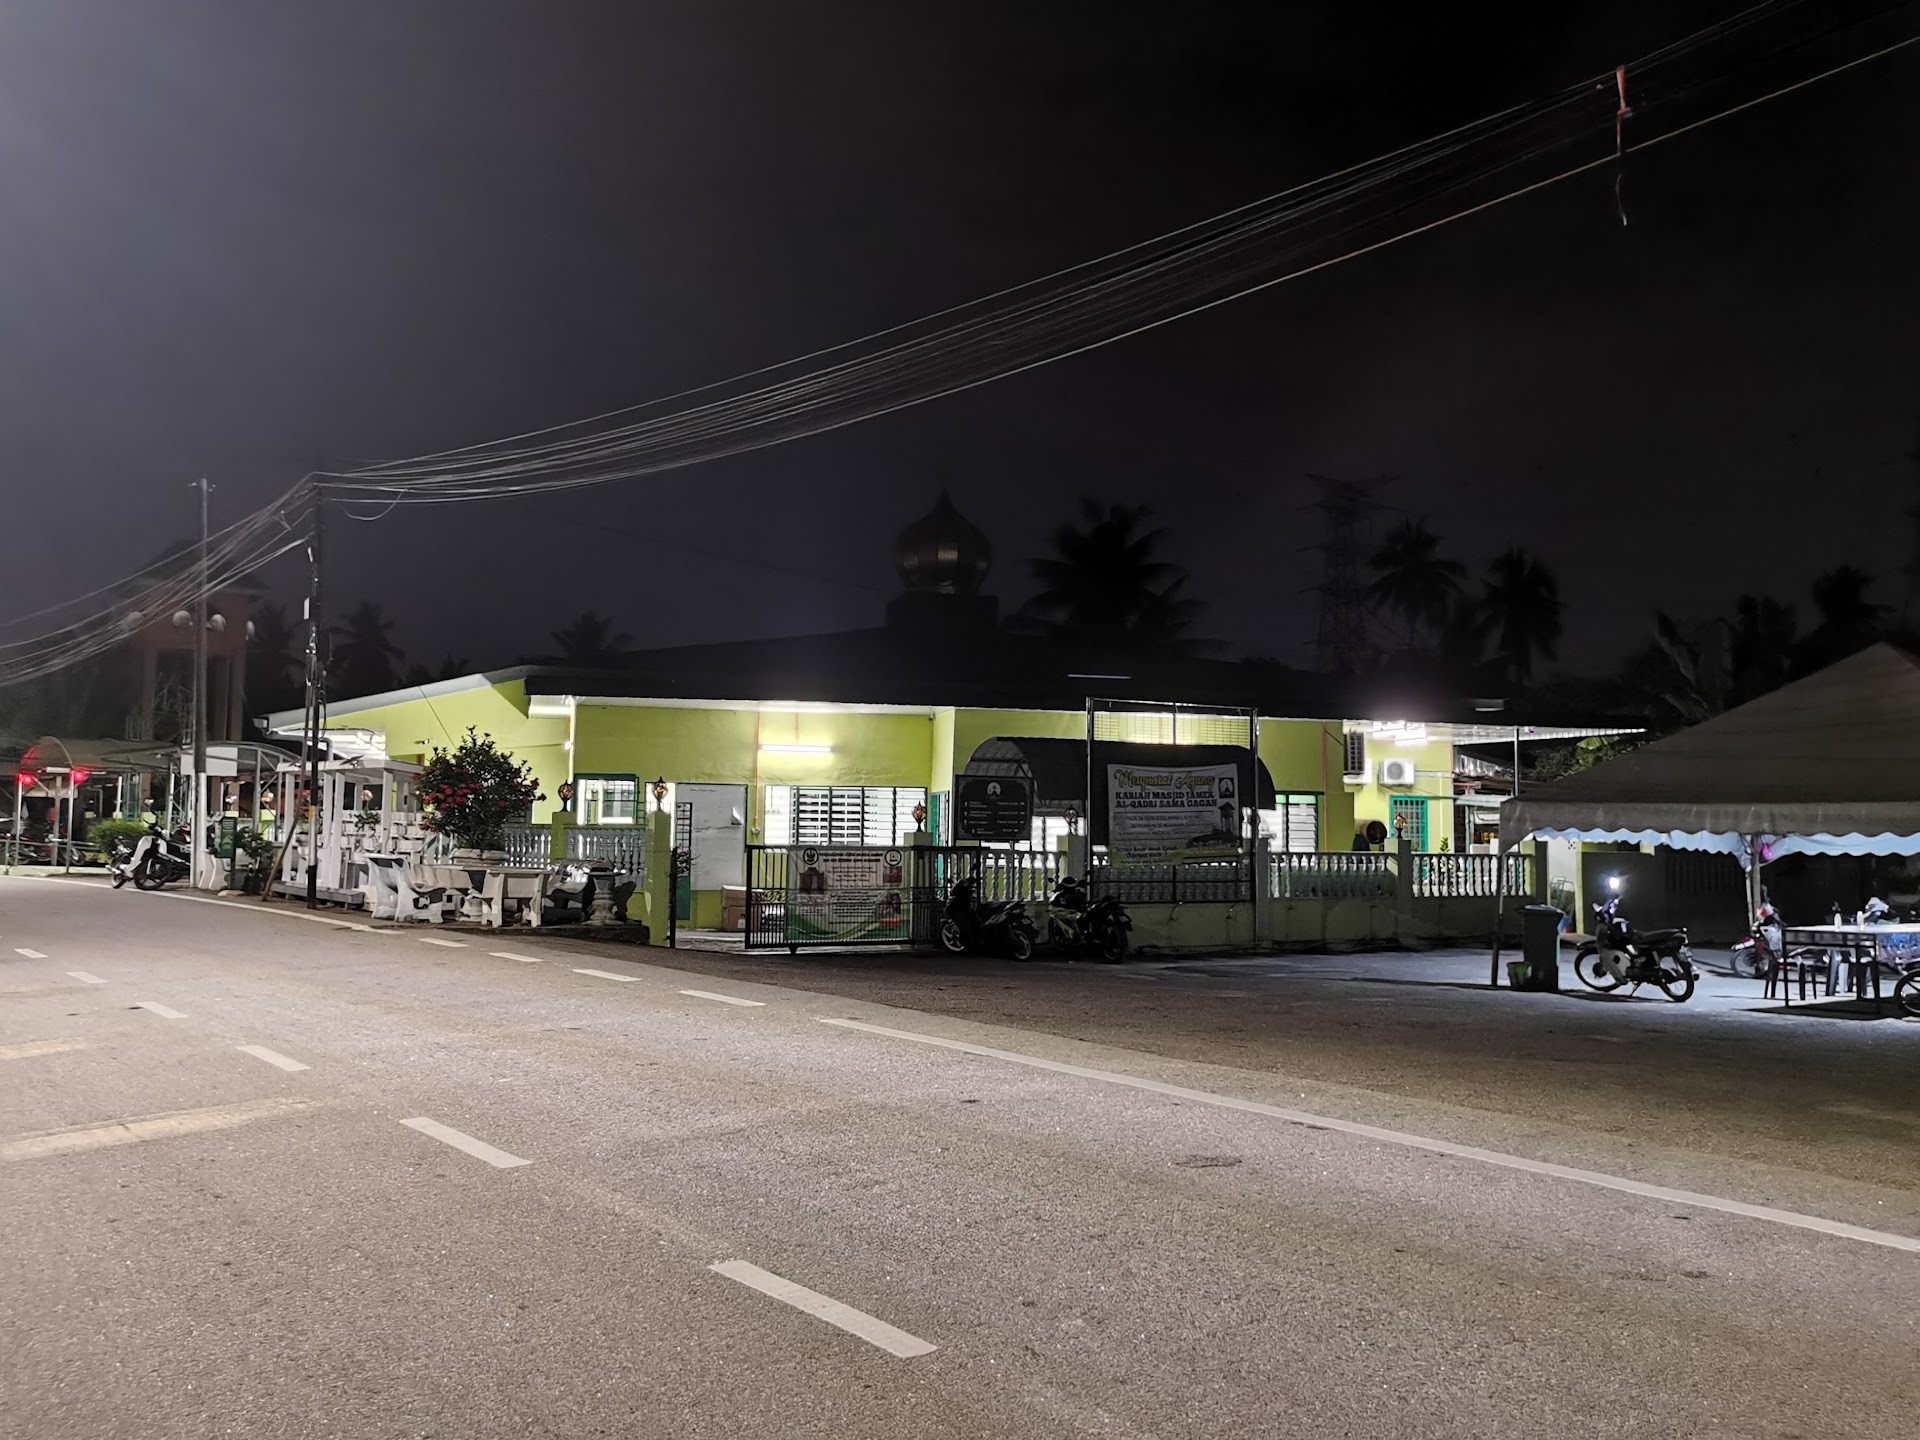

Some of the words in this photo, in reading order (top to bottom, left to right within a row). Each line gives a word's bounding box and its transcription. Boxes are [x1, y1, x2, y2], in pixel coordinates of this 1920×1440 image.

[1152, 792, 1184, 800] MASJID
[1186, 791, 1214, 800] JAMEK
[1115, 800, 1157, 808] AL-QADRI
[1159, 800, 1185, 808] SAMA
